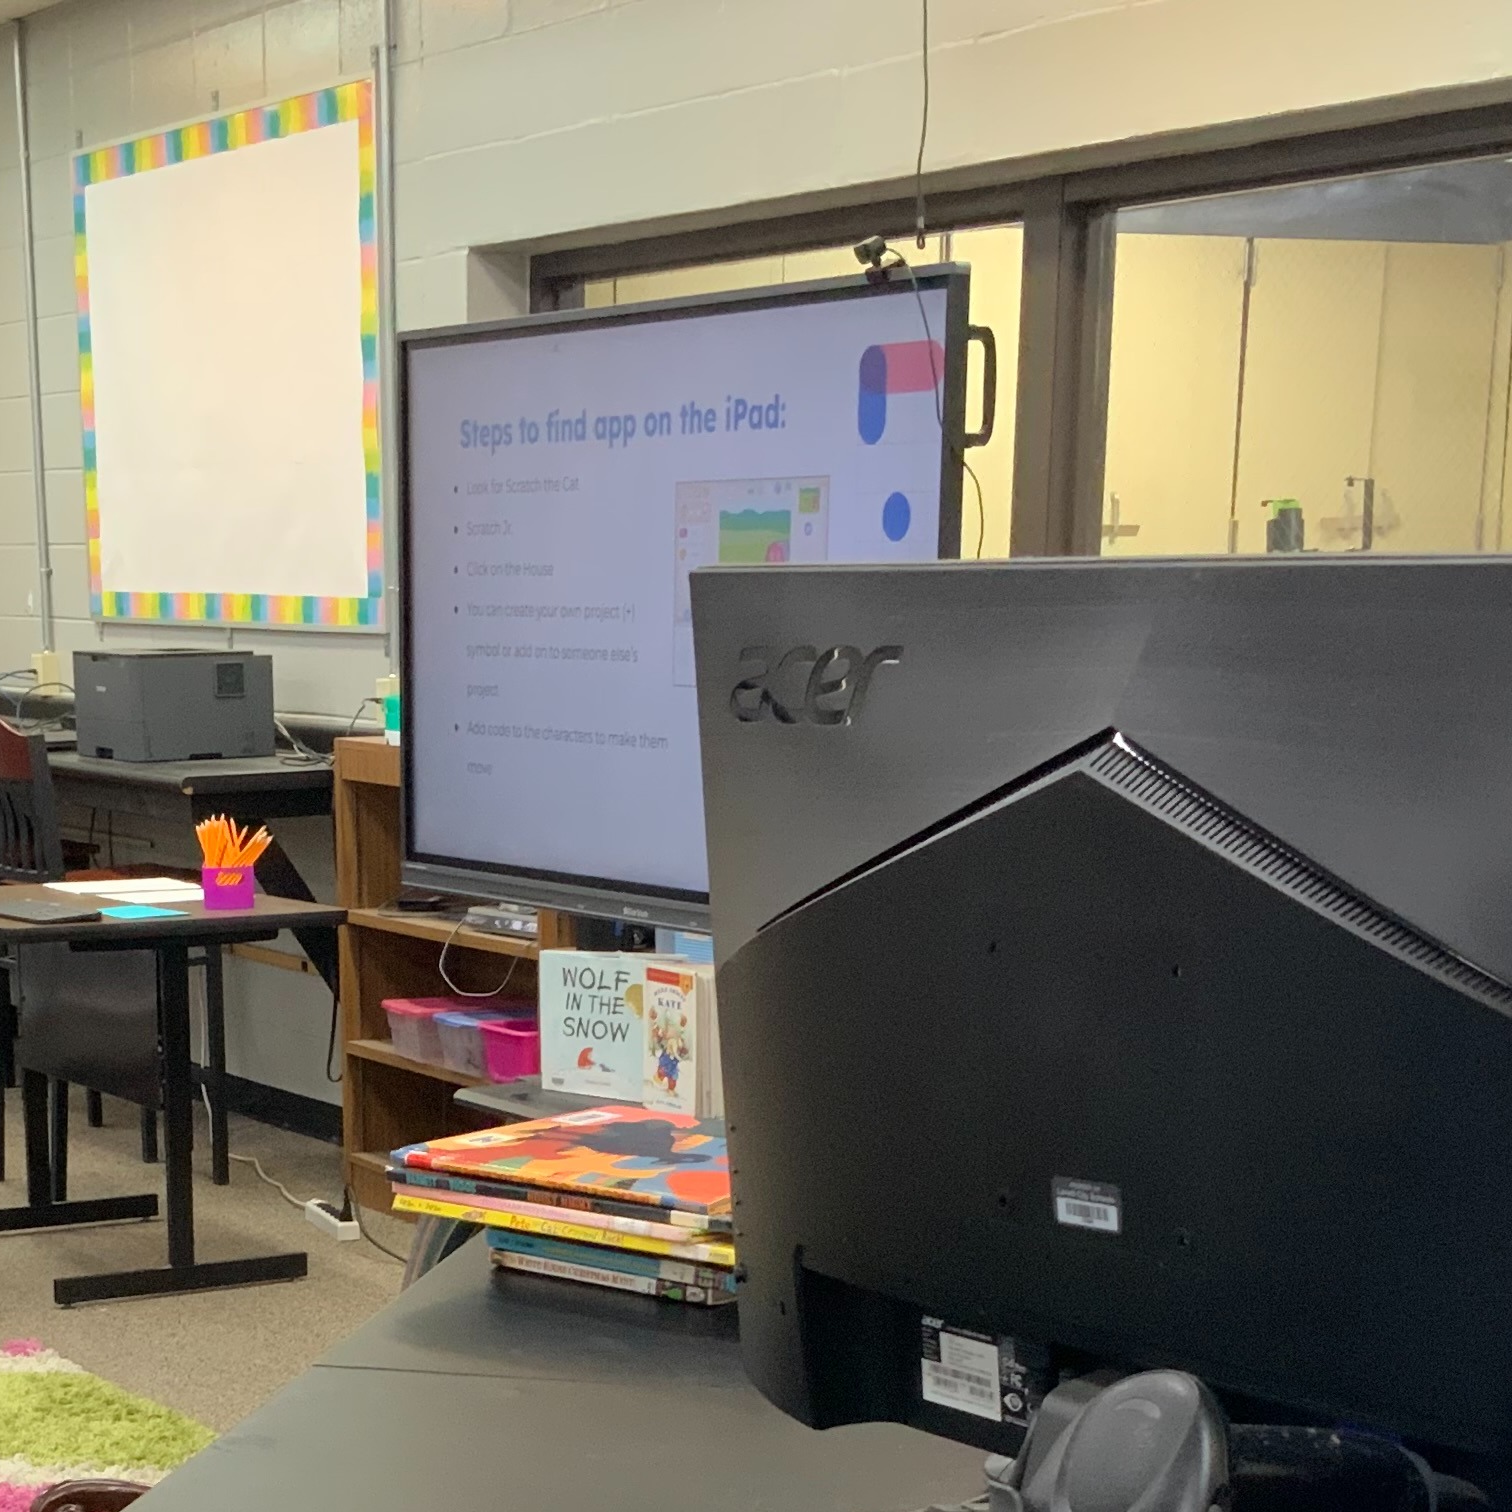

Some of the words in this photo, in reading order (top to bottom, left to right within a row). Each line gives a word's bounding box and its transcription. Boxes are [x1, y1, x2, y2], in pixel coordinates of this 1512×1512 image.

[459, 418, 513, 456] Steps
[519, 416, 539, 445] to
[546, 408, 587, 442] find
[594, 413, 637, 448] app
[644, 410, 672, 437] on
[680, 400, 717, 435] the
[725, 393, 787, 432] iPad:
[466, 480, 489, 496] Look
[490, 478, 504, 494] for
[505, 477, 541, 494] Scratch
[544, 476, 560, 493] the
[562, 475, 580, 492] Cat
[466, 520, 501, 536] Scratch
[466, 561, 489, 577] Click
[490, 563, 504, 576] on
[505, 561, 522, 576] the
[523, 562, 555, 577] House
[466, 602, 485, 617] You
[487, 604, 504, 617] can
[505, 603, 534, 617] create
[534, 605, 558, 621] your
[559, 605, 582, 618] own
[584, 604, 621, 622] project
[466, 643, 501, 660] symbol
[502, 645, 512, 658] or
[514, 644, 533, 659] add
[535, 646, 548, 659] on
[548, 646, 560, 659] to
[561, 648, 609, 661] someone
[610, 646, 639, 663] else's
[729, 644, 905, 727] acer
[467, 721, 487, 736] Add
[488, 723, 511, 737] code
[512, 724, 523, 738] to
[524, 725, 540, 740] the
[541, 726, 593, 744] characters
[594, 731, 606, 745] to
[608, 732, 637, 747] make
[639, 733, 669, 749] them
[562, 966, 630, 991] WOLF
[565, 992, 583, 1011] IN
[588, 994, 625, 1015] THE
[563, 1016, 630, 1042] SNOW
